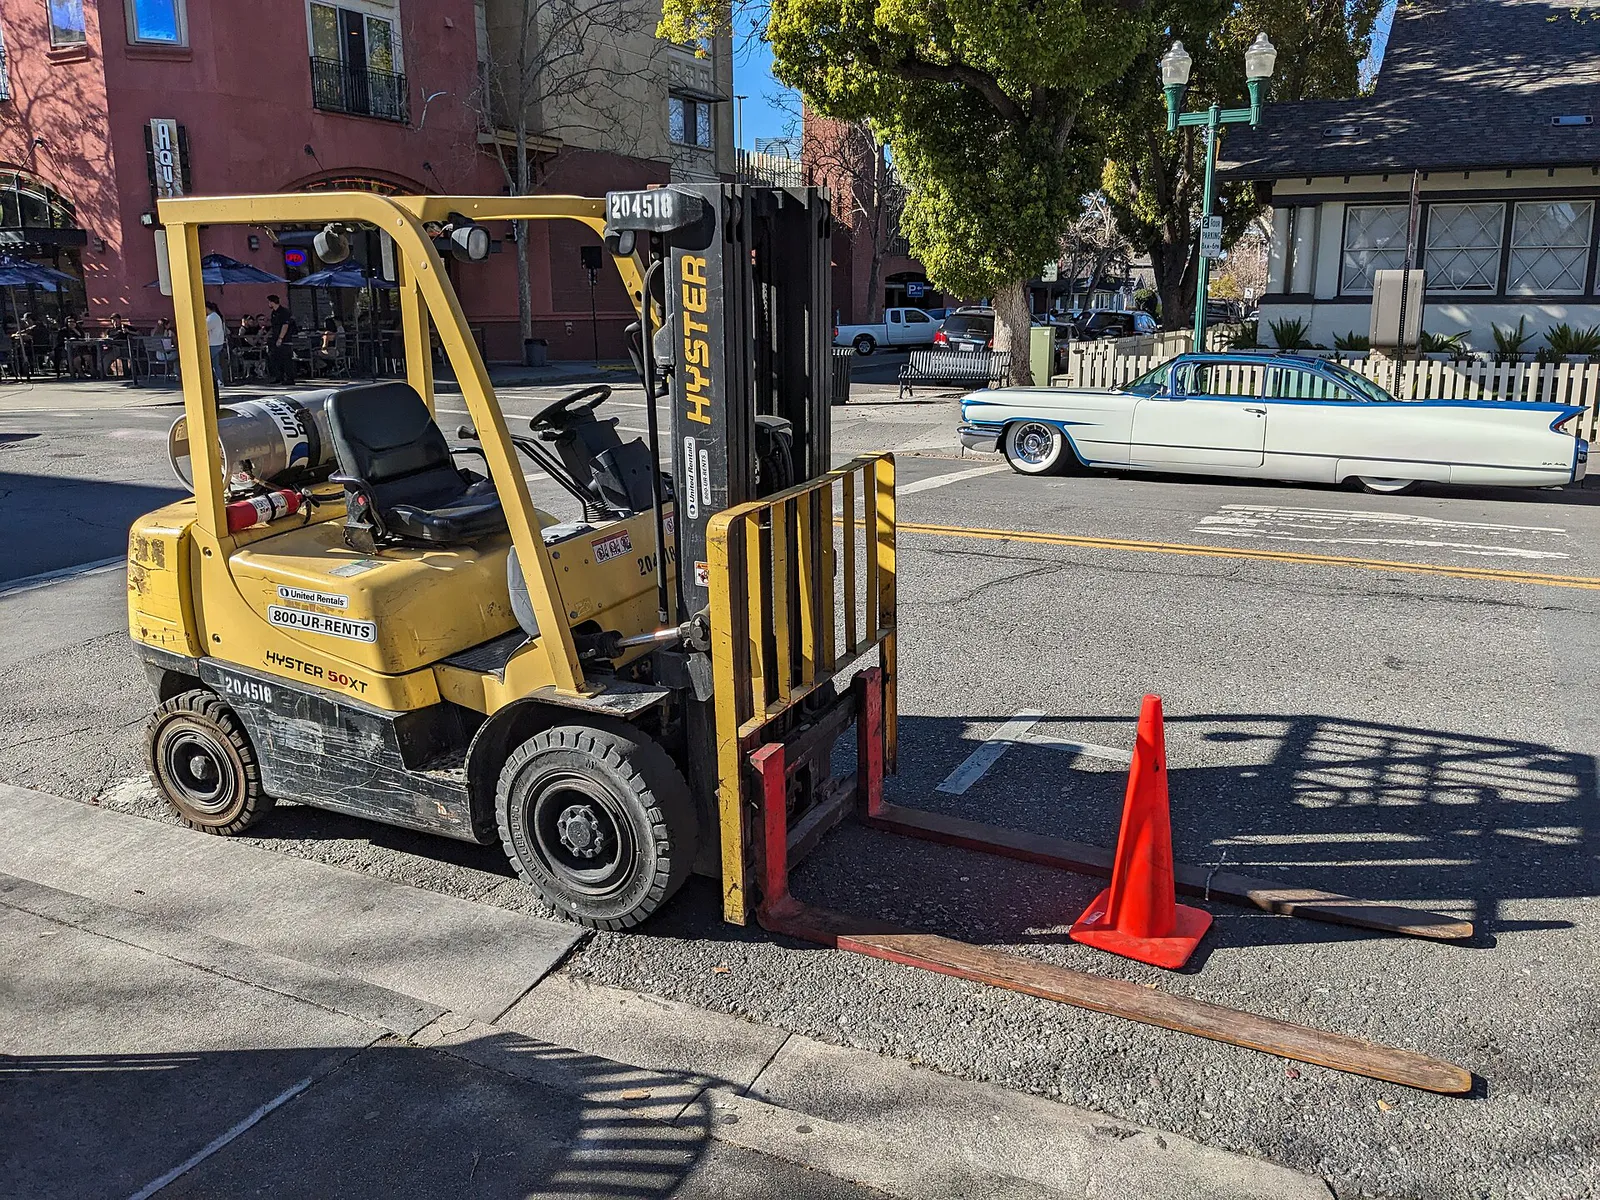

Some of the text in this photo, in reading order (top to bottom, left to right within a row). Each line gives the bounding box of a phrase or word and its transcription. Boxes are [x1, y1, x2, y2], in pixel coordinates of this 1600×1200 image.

[611, 193, 673, 219] 204518
[681, 255, 711, 425] HYSTER
[290, 590, 346, 606] United Rentals
[273, 610, 370, 638] 800-UR-RENTS
[266, 650, 324, 679] HYSTER
[225, 676, 272, 704] 204518
